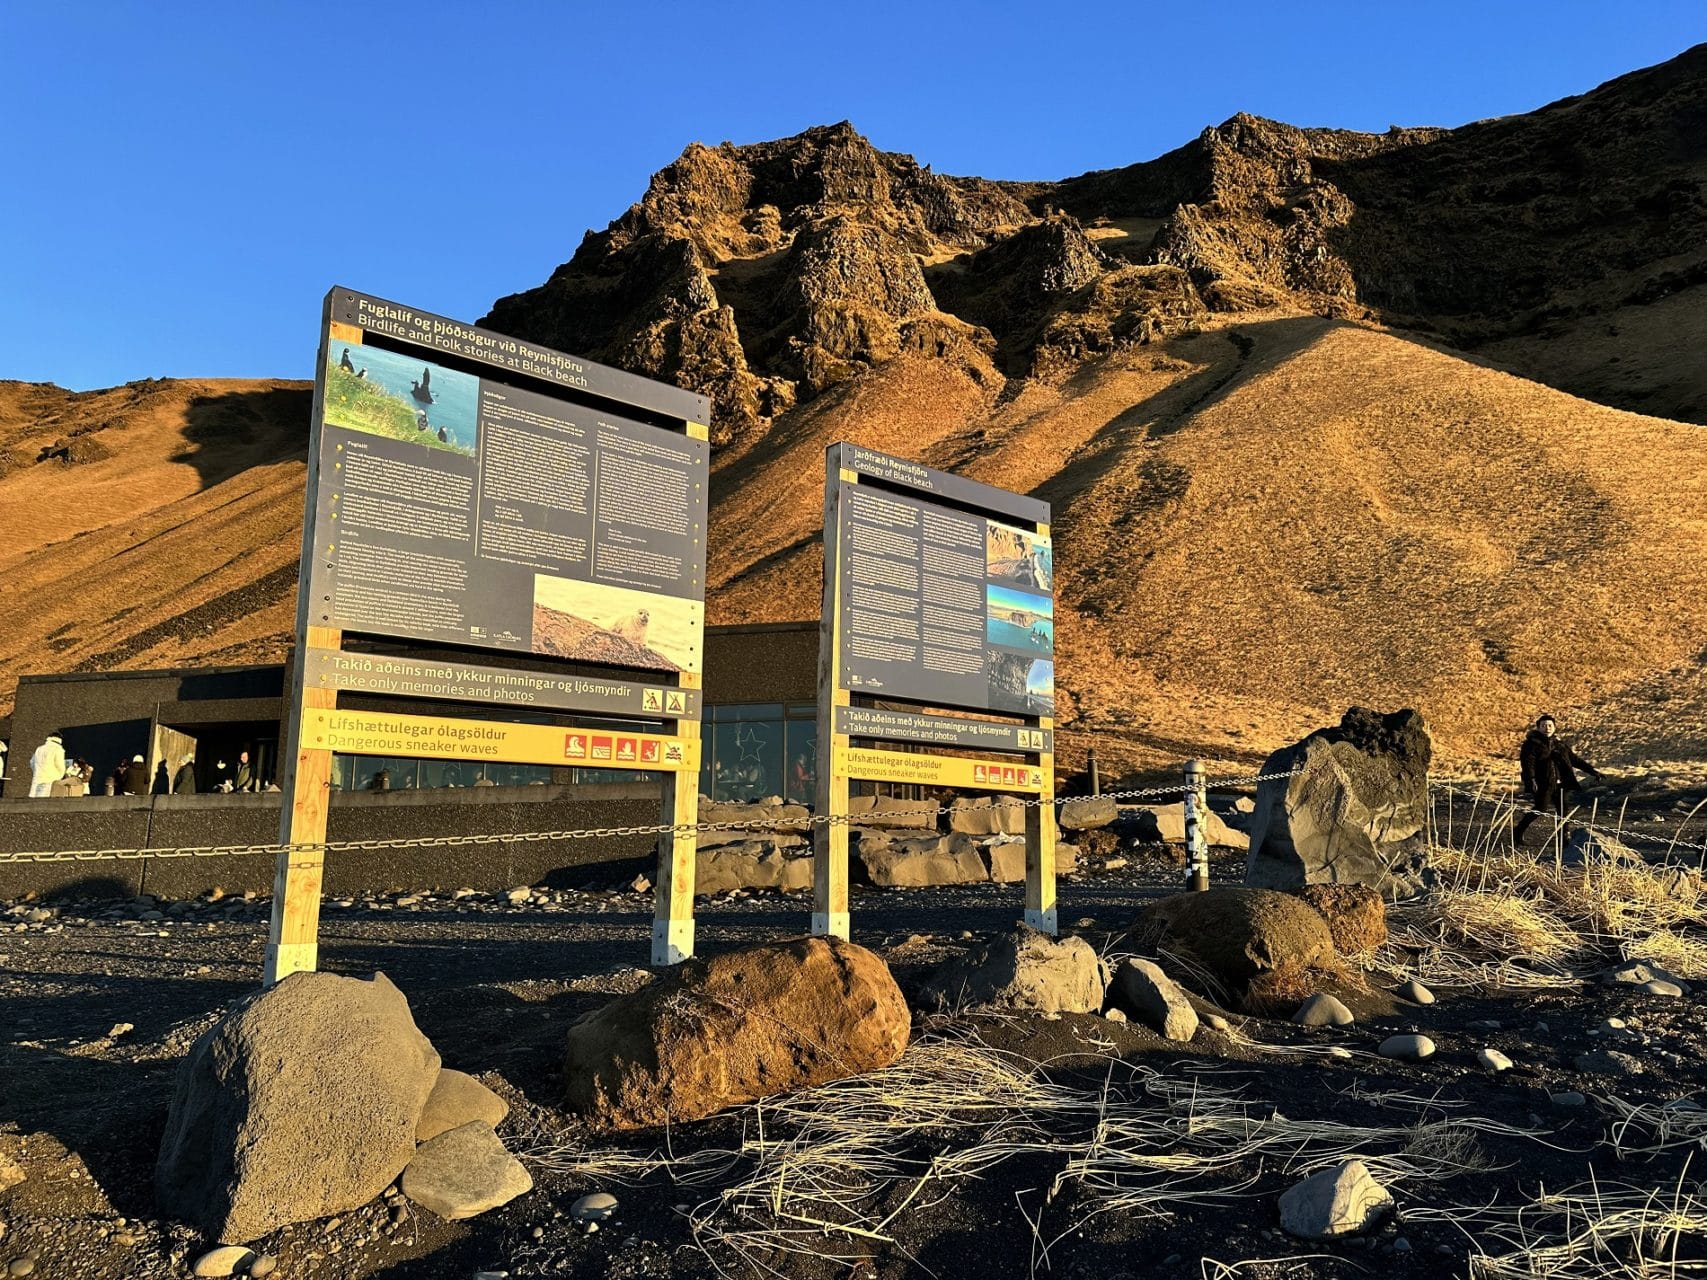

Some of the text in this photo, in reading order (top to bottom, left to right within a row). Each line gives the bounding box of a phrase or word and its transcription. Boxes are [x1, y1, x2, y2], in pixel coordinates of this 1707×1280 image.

[359, 299, 583, 373] Fuglalíf og þjóðsögur við Reynisfjöru
[358, 313, 588, 387] Birdlife and Folk stories at Black beach
[854, 460, 934, 489] Geology of Black beach
[332, 673, 535, 701] Take only memories and photos
[333, 657, 632, 697] Takið aðeins með ykkur minningar og ljósmyndir
[437, 724, 507, 740] ólagsöldur
[849, 711, 1011, 737] Takið aðeins með ykkur minningar og ljósmyndir
[849, 722, 958, 741] Take only memories and photos
[328, 734, 499, 755] Dangerous sneaker waves
[847, 764, 939, 780] Dangerous sneaker waves
